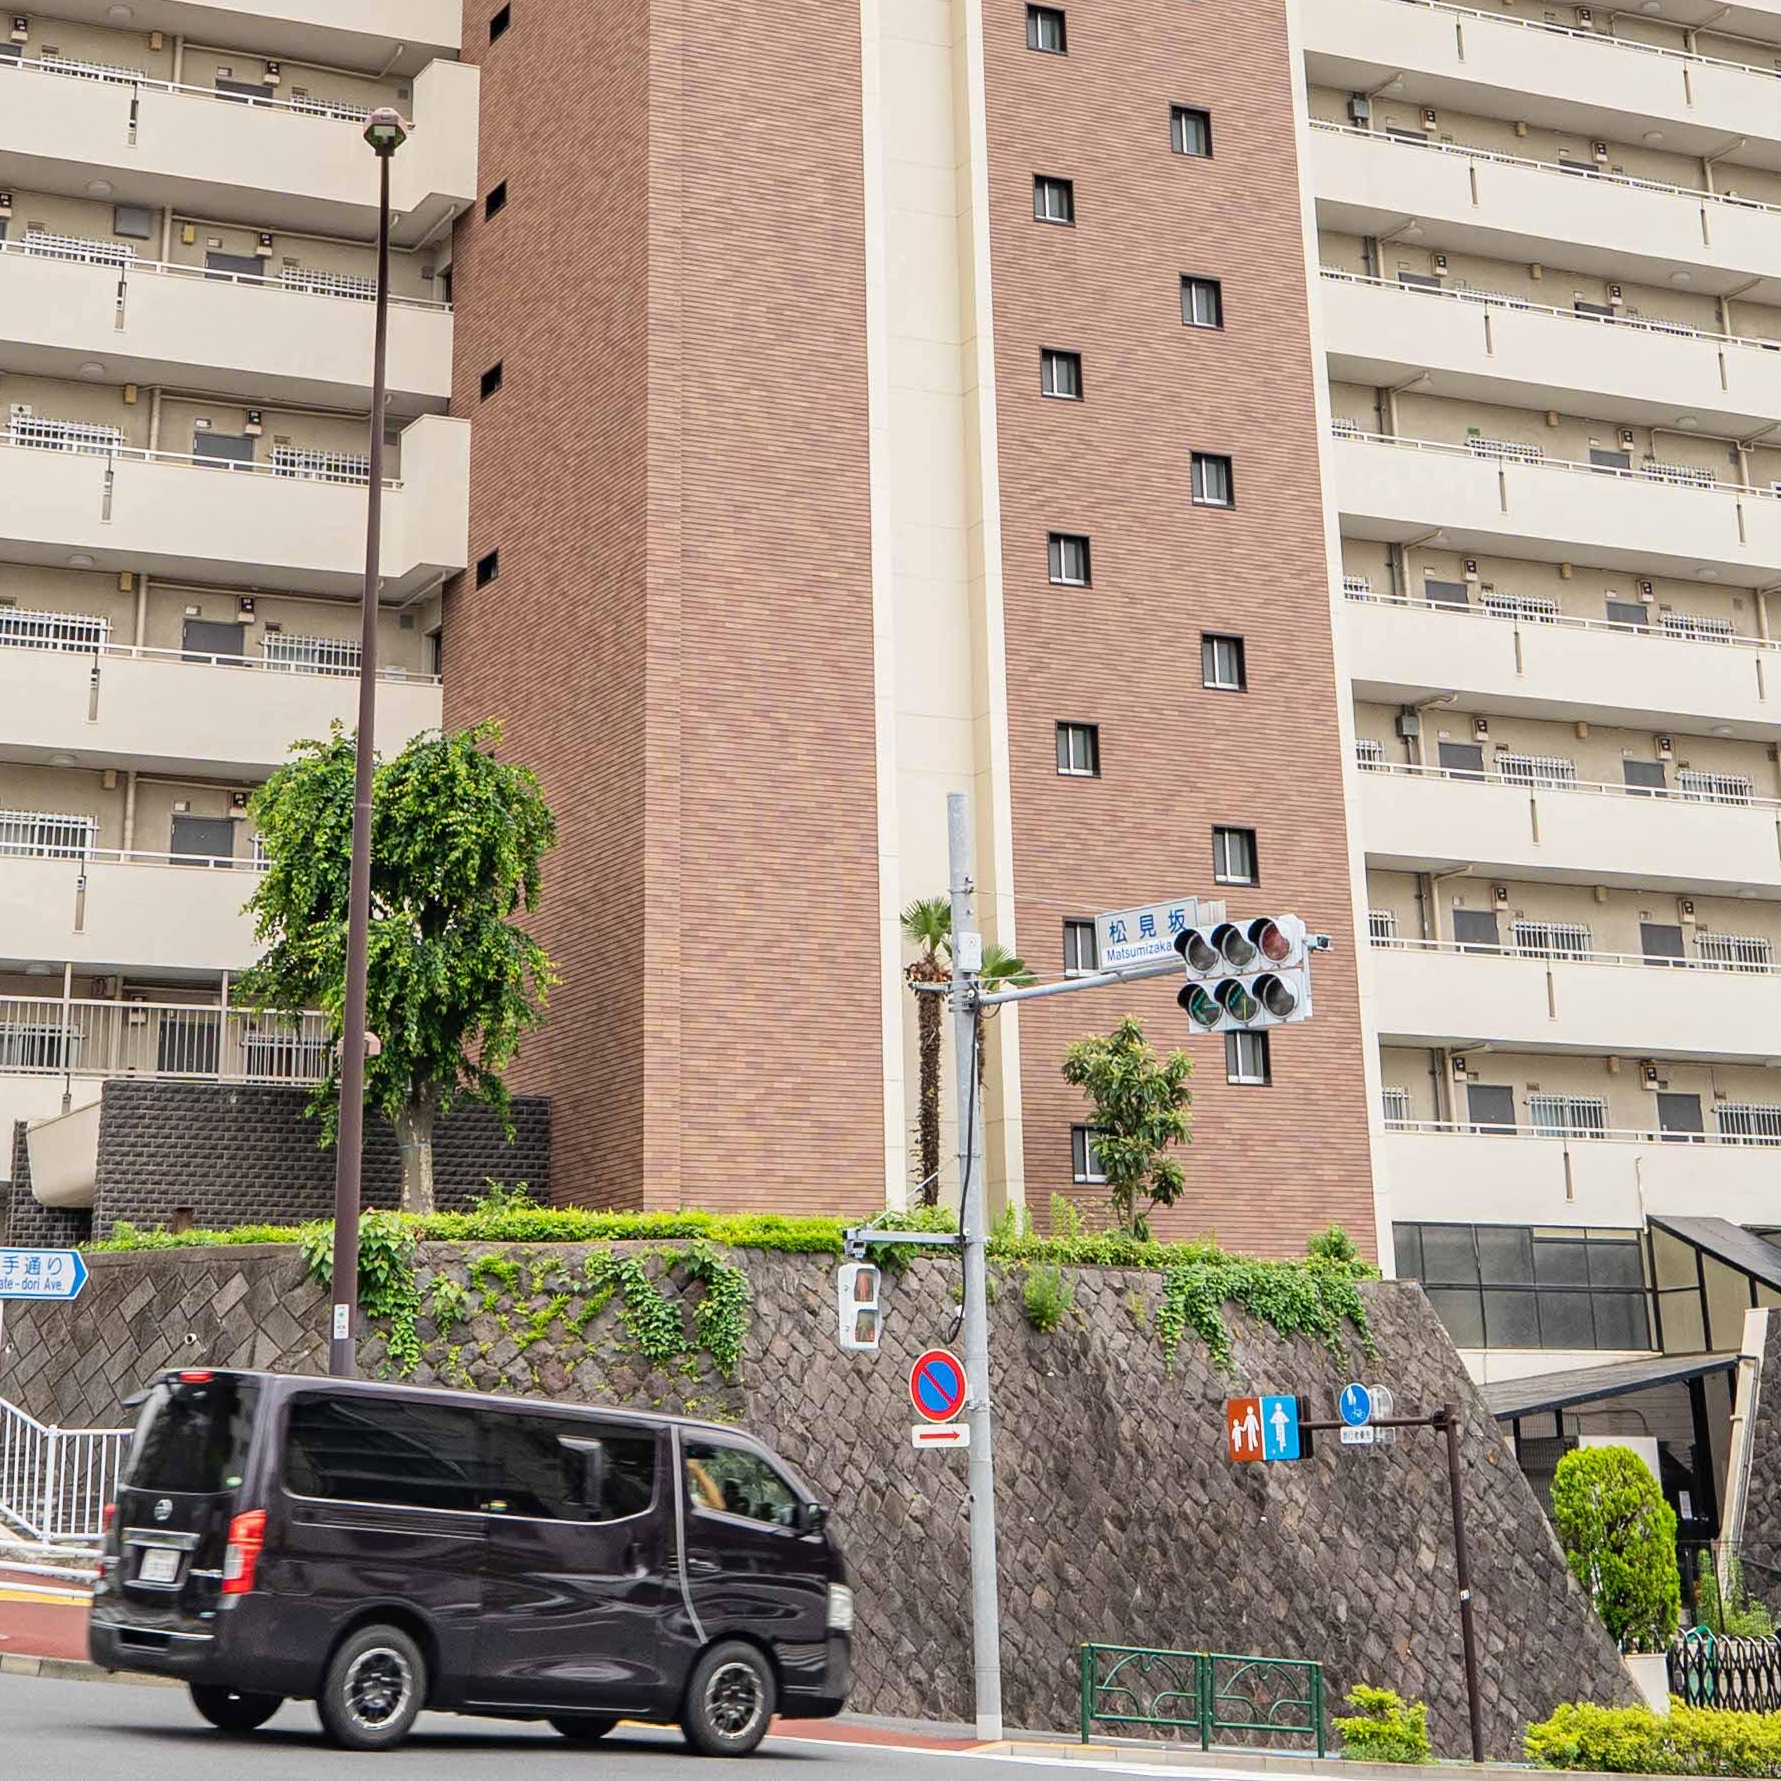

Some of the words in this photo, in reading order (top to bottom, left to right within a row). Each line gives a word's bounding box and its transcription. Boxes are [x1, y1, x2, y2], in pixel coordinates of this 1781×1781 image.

[1108, 909, 1186, 945] 松見坂
[1107, 940, 1172, 961] Matsumizaka
[44, 1277, 65, 1291] Ave.
